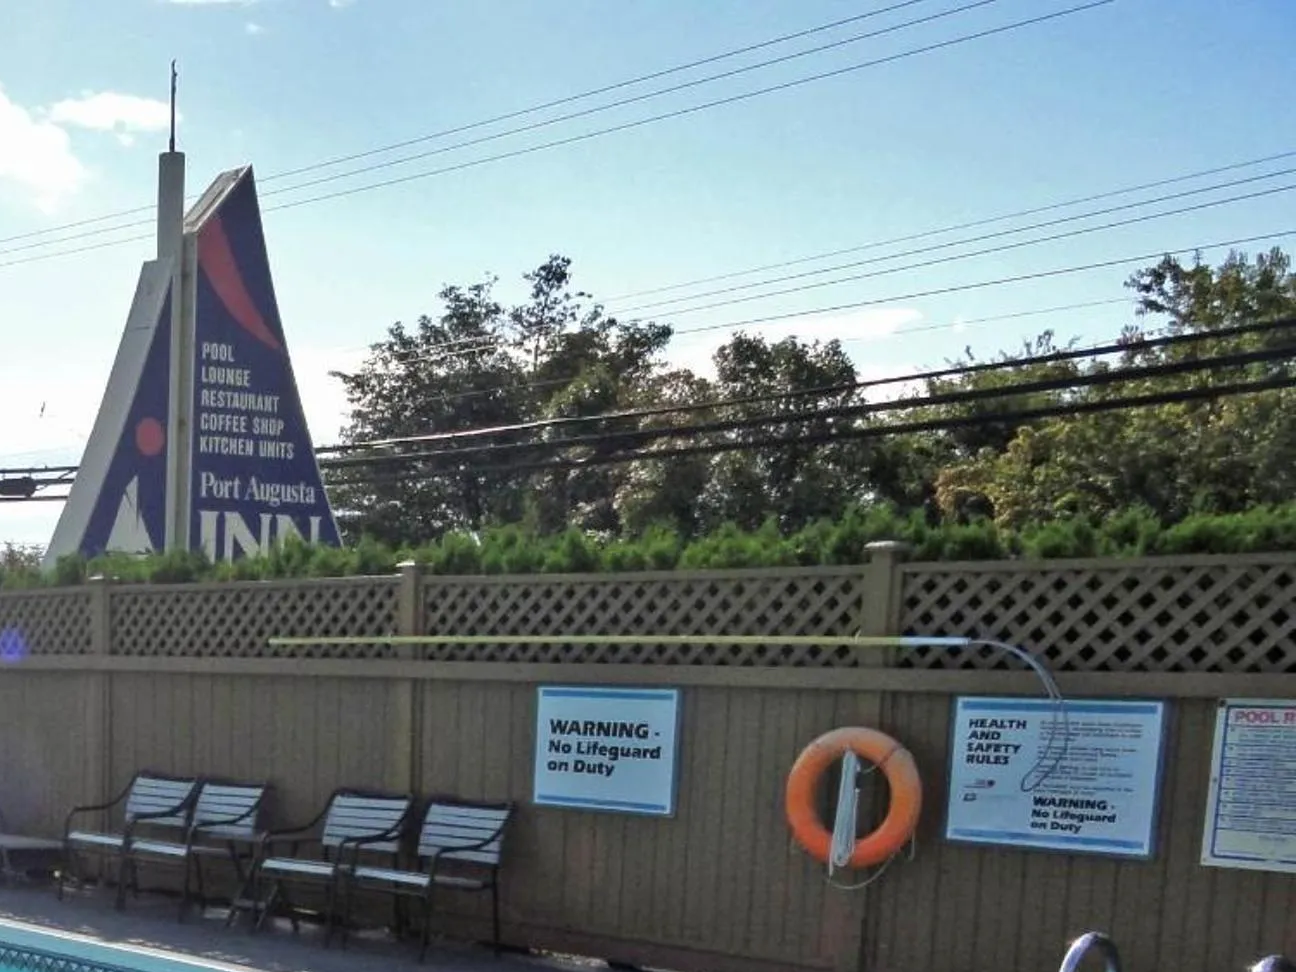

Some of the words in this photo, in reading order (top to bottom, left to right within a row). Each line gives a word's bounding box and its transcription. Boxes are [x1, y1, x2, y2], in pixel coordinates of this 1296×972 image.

[202, 342, 235, 362] POOL
[201, 366, 251, 387] LOUNGE
[201, 388, 280, 412] RESTAURANT
[200, 412, 248, 433] COFFEE
[252, 416, 285, 436] SHOP
[200, 436, 254, 456] KITCHEN
[259, 440, 294, 459] UNITS
[201, 471, 241, 499] Port
[244, 476, 316, 507] Augusta
[199, 510, 322, 568] INN
[969, 719, 1027, 729] HEALTH
[1235, 711, 1280, 723] POOL
[550, 719, 649, 739] WARNING
[969, 730, 1001, 740] AND
[548, 740, 572, 754] No
[576, 741, 661, 761] Lifeguard
[967, 743, 1022, 754] SAFETY
[547, 760, 569, 772] on
[573, 760, 615, 776] Duty
[966, 754, 1010, 765] RULES
[1033, 796, 1108, 810] WARNING
[1031, 809, 1049, 818] No
[1053, 810, 1116, 823] Lifeguard
[1030, 822, 1046, 830] on
[1050, 821, 1082, 834] Duty
